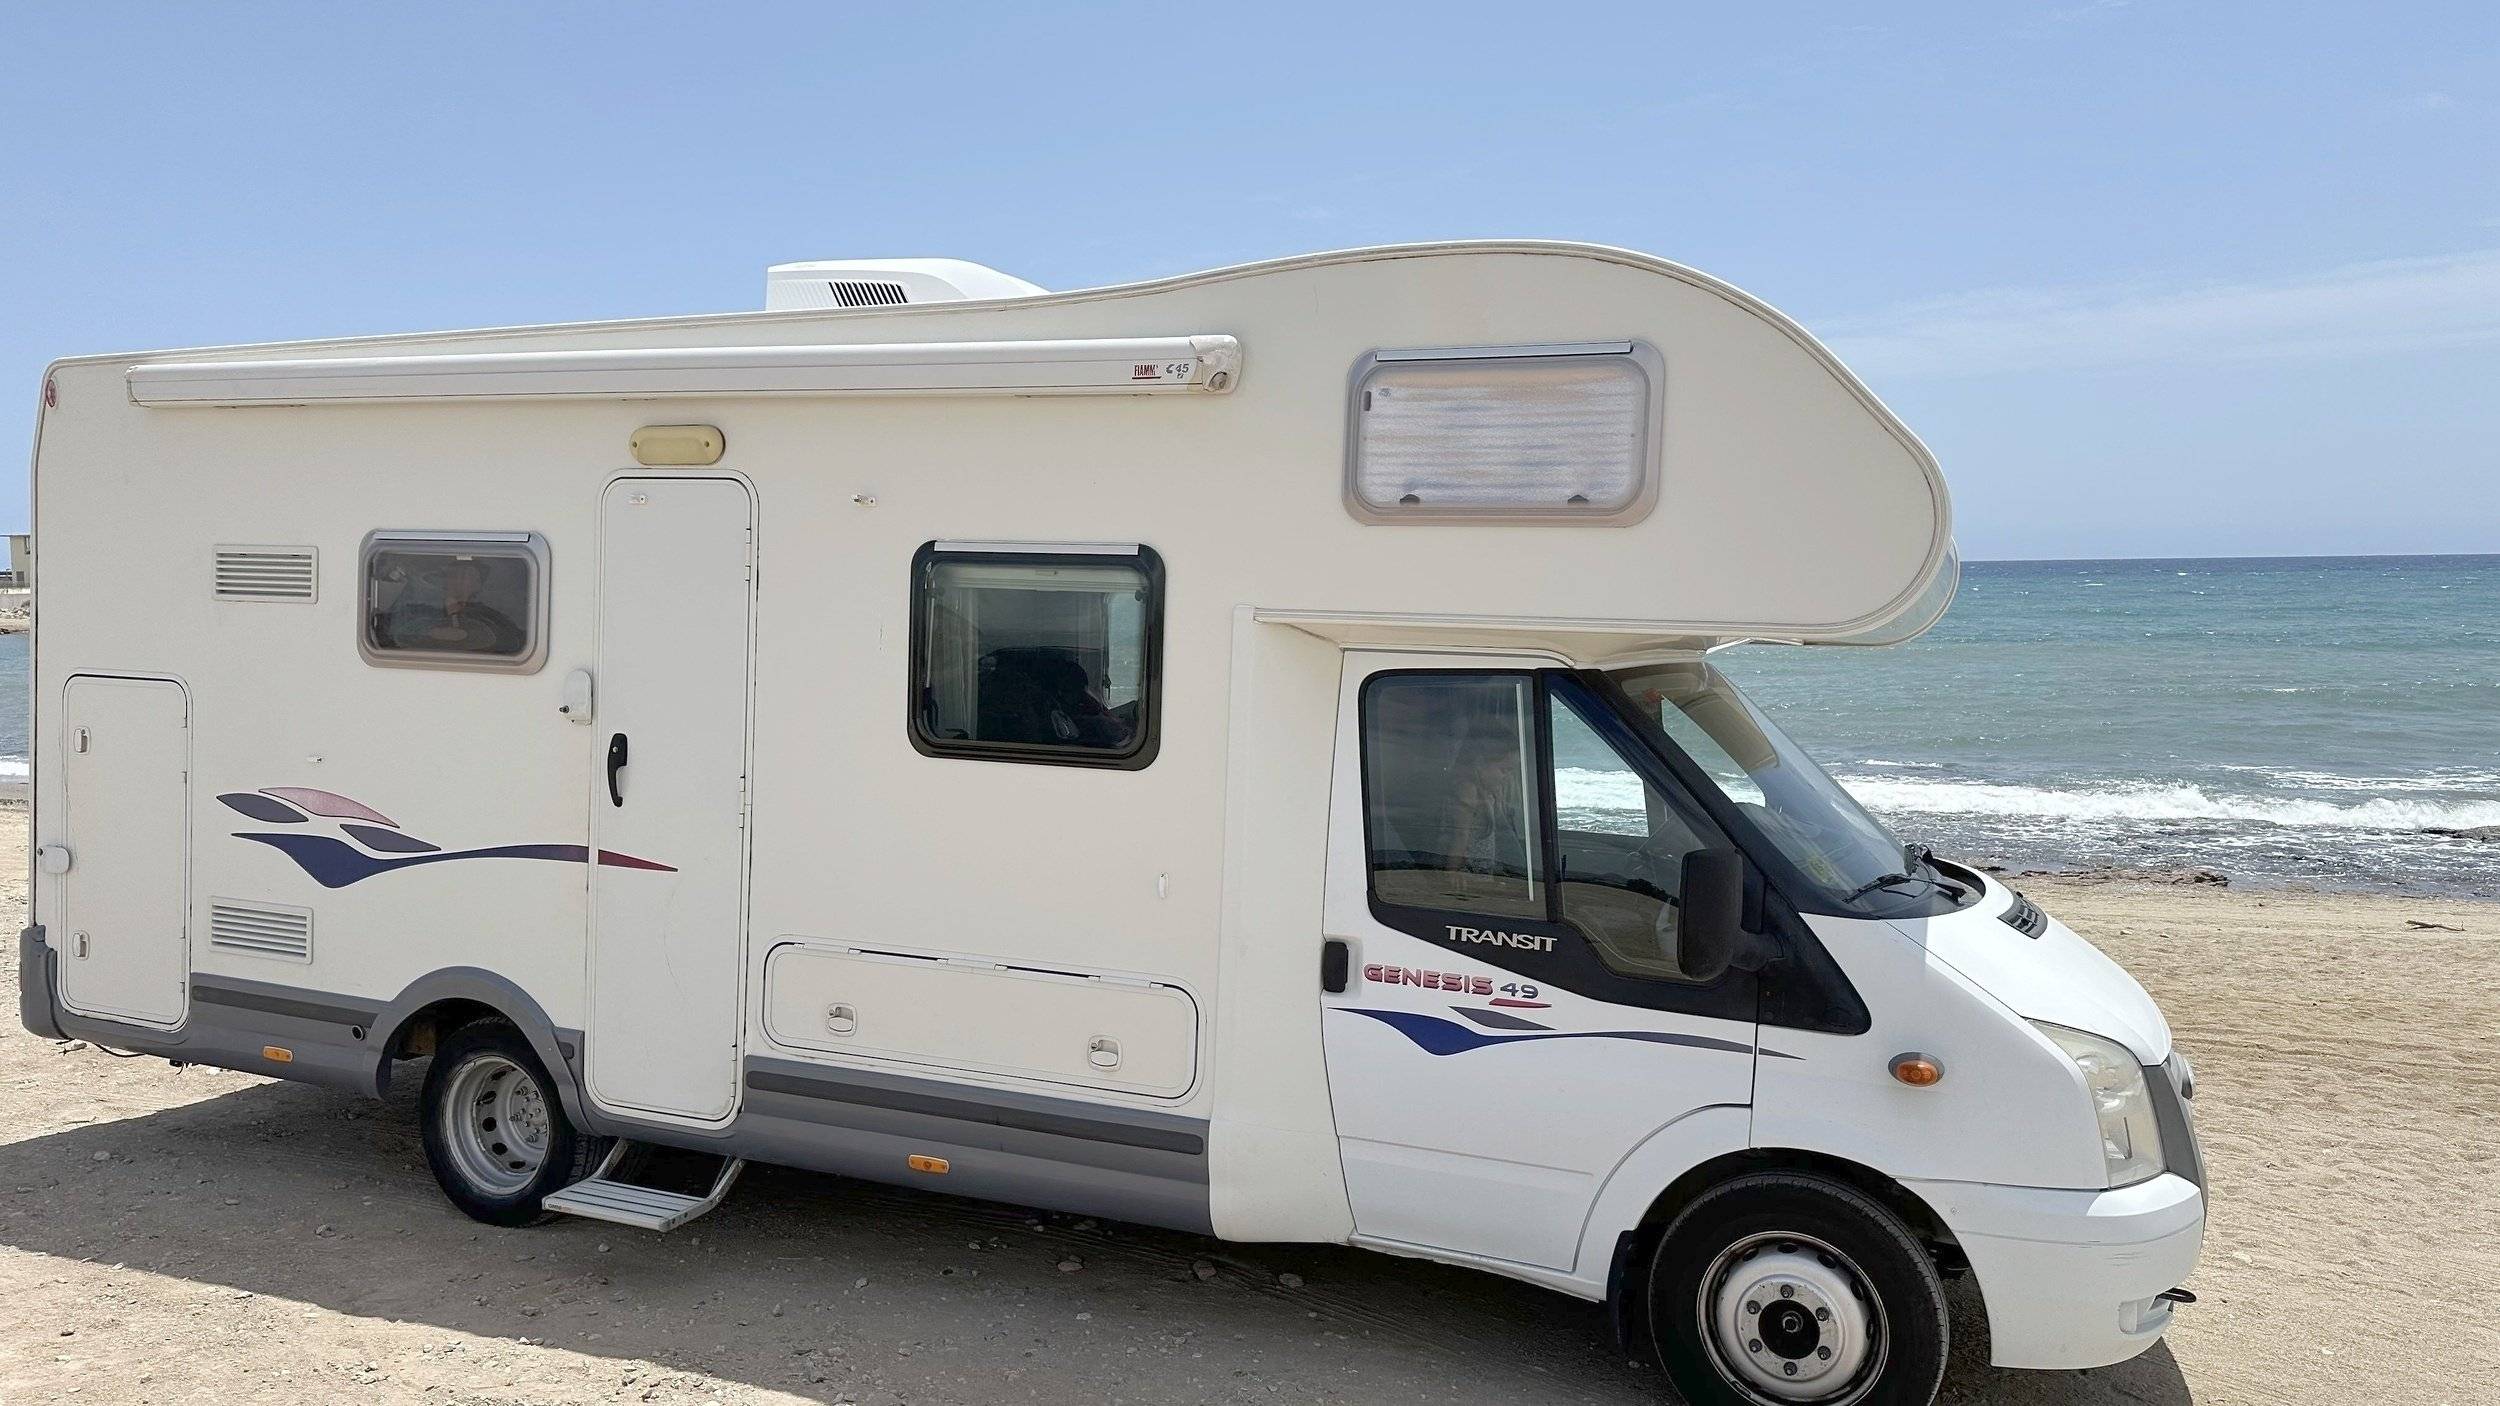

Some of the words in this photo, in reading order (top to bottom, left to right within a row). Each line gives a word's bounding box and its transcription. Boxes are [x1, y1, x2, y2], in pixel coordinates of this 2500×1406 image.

[1134, 364, 1158, 376] FIAMM
[1445, 925, 1558, 952] TRANSIT
[1363, 963, 1494, 996] GENESIS
[1499, 982, 1539, 999] 49
